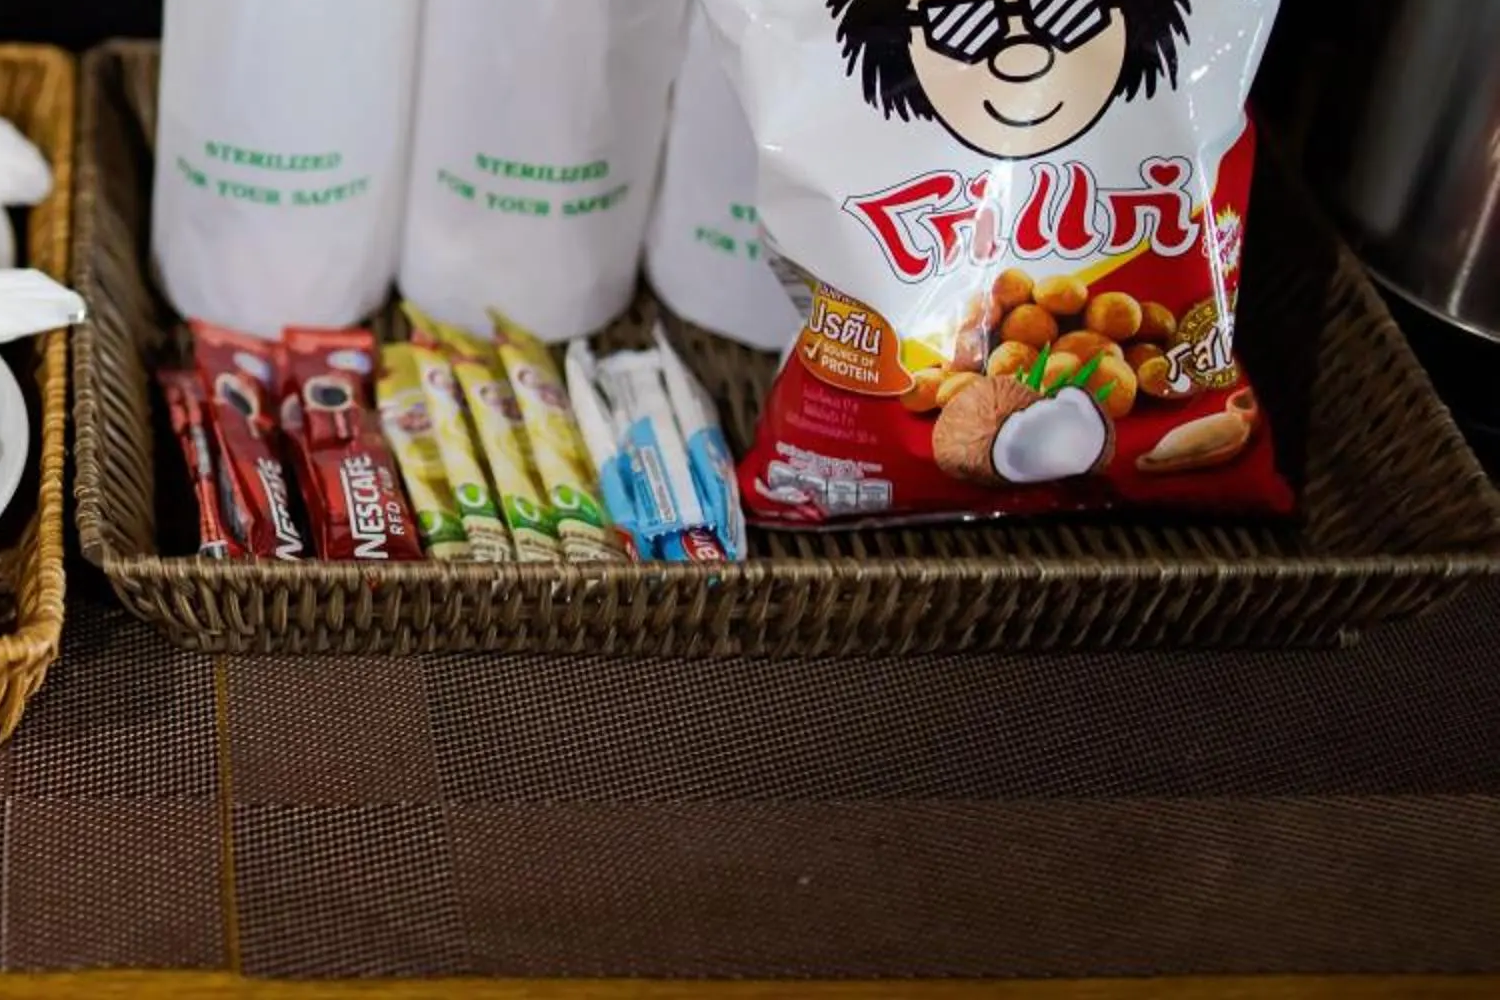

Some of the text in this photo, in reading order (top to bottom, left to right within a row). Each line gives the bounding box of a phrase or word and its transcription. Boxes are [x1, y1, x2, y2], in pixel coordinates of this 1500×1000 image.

[204, 141, 342, 171] STERILIZED
[476, 152, 609, 182] STERILIZED
[217, 180, 281, 206] YOUR
[291, 176, 370, 206] SAFETY
[437, 168, 476, 200] FOR
[486, 191, 551, 215] YOUR
[821, 354, 879, 384] PROTEIN
[385, 501, 405, 536] RED
